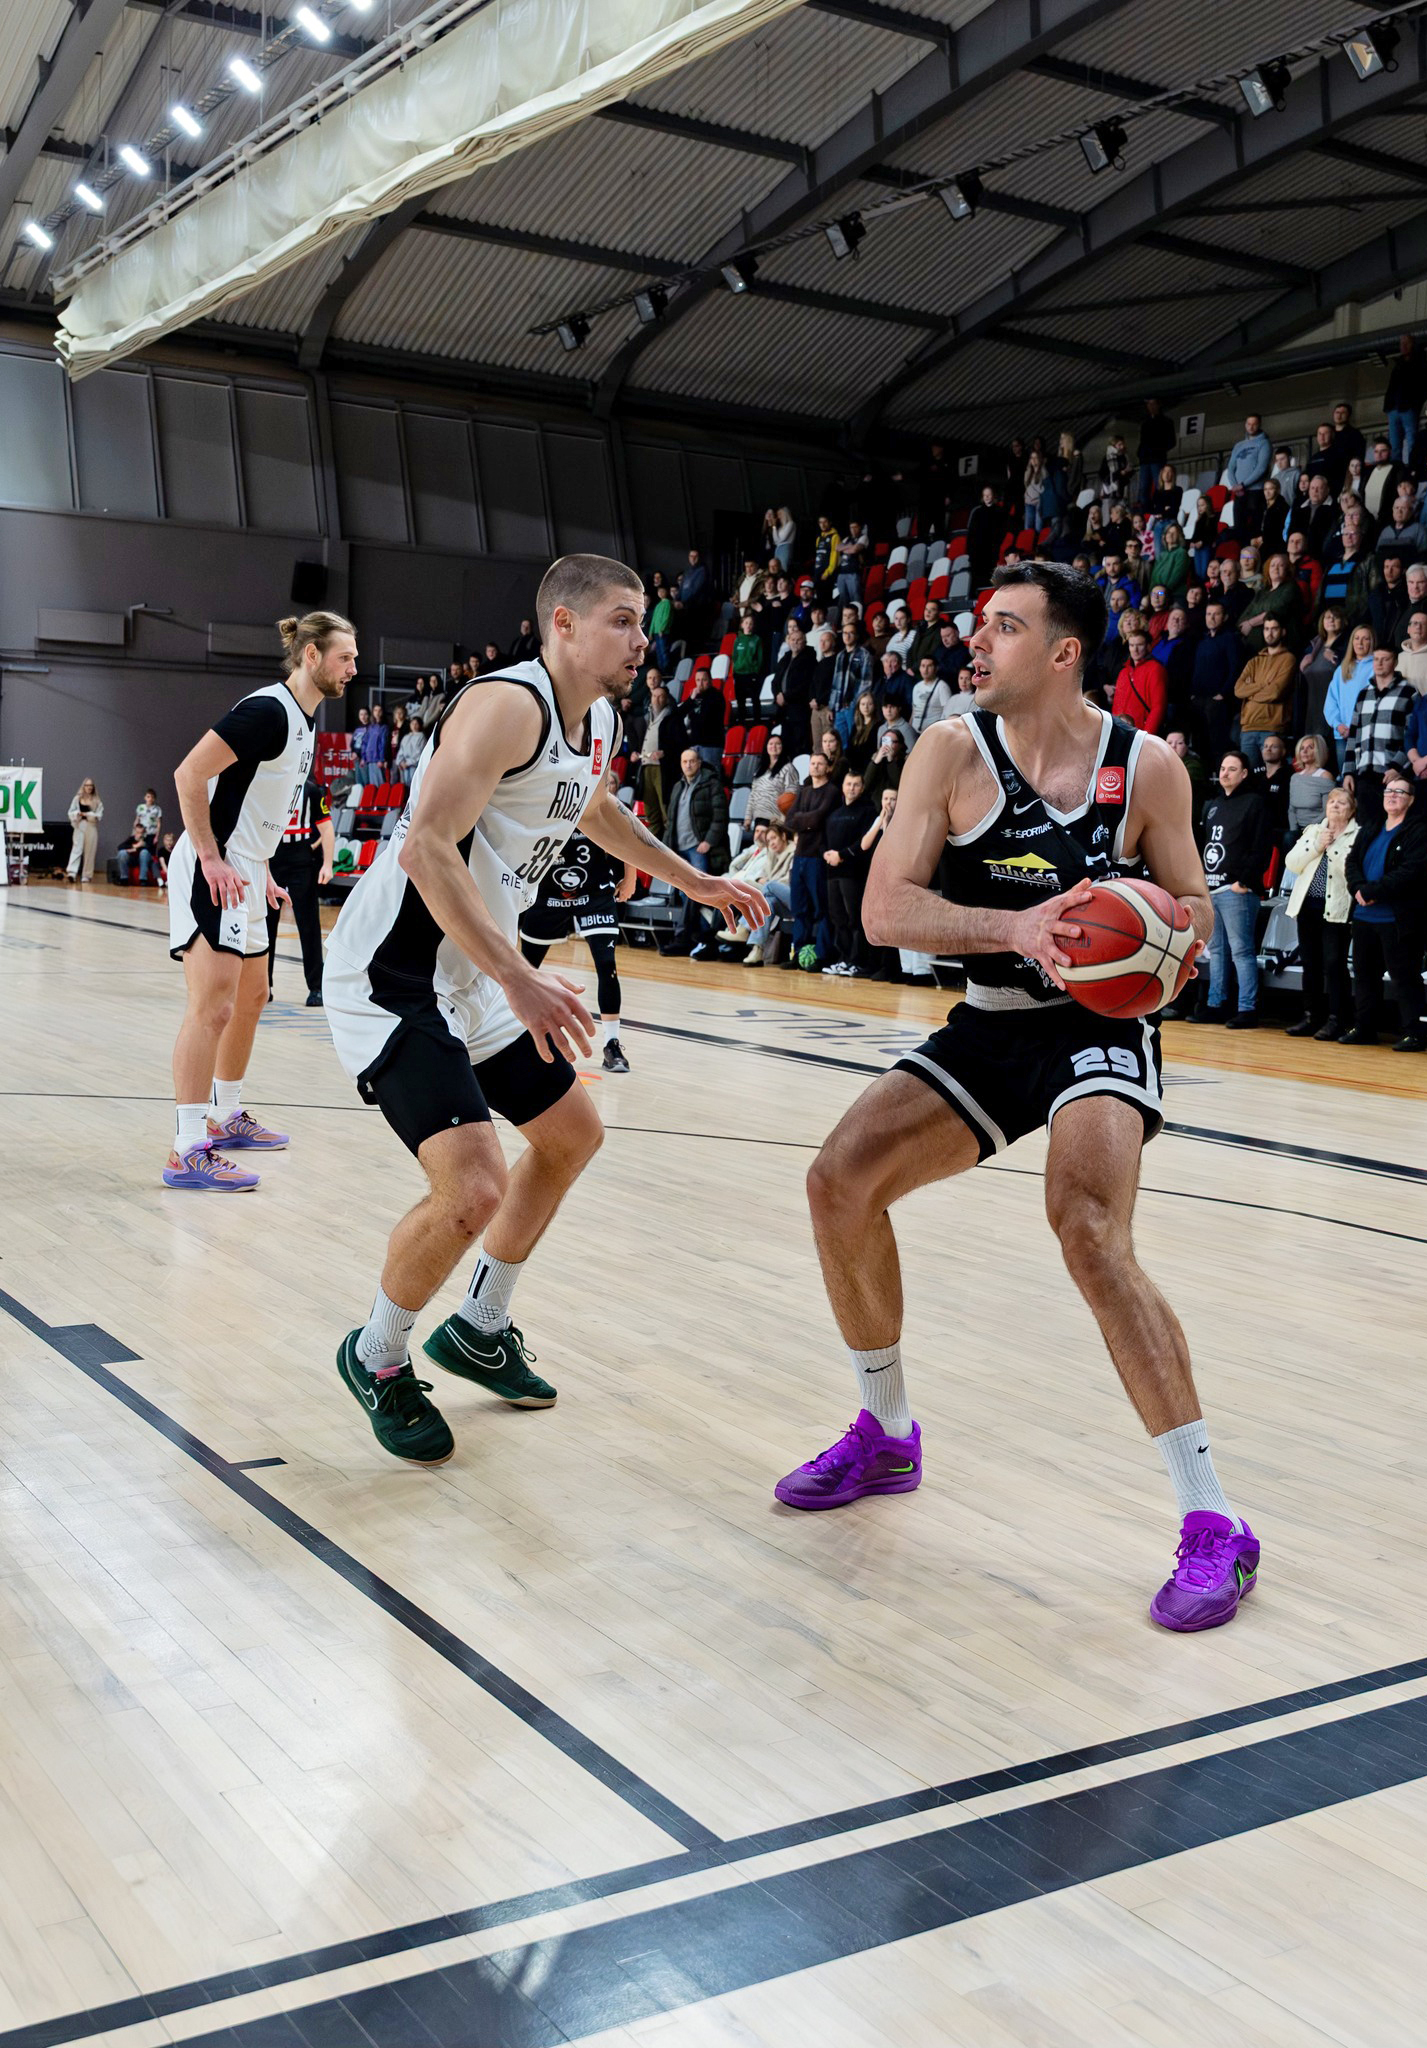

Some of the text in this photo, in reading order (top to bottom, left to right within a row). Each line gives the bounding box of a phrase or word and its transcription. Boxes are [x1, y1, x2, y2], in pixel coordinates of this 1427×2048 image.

[1186, 416, 1198, 435] E
[963, 457, 973, 474] F
[1211, 825, 1224, 841] 13
[514, 836, 564, 884] 35
[576, 844, 591, 864] 3
[1070, 1046, 1140, 1078] 29
